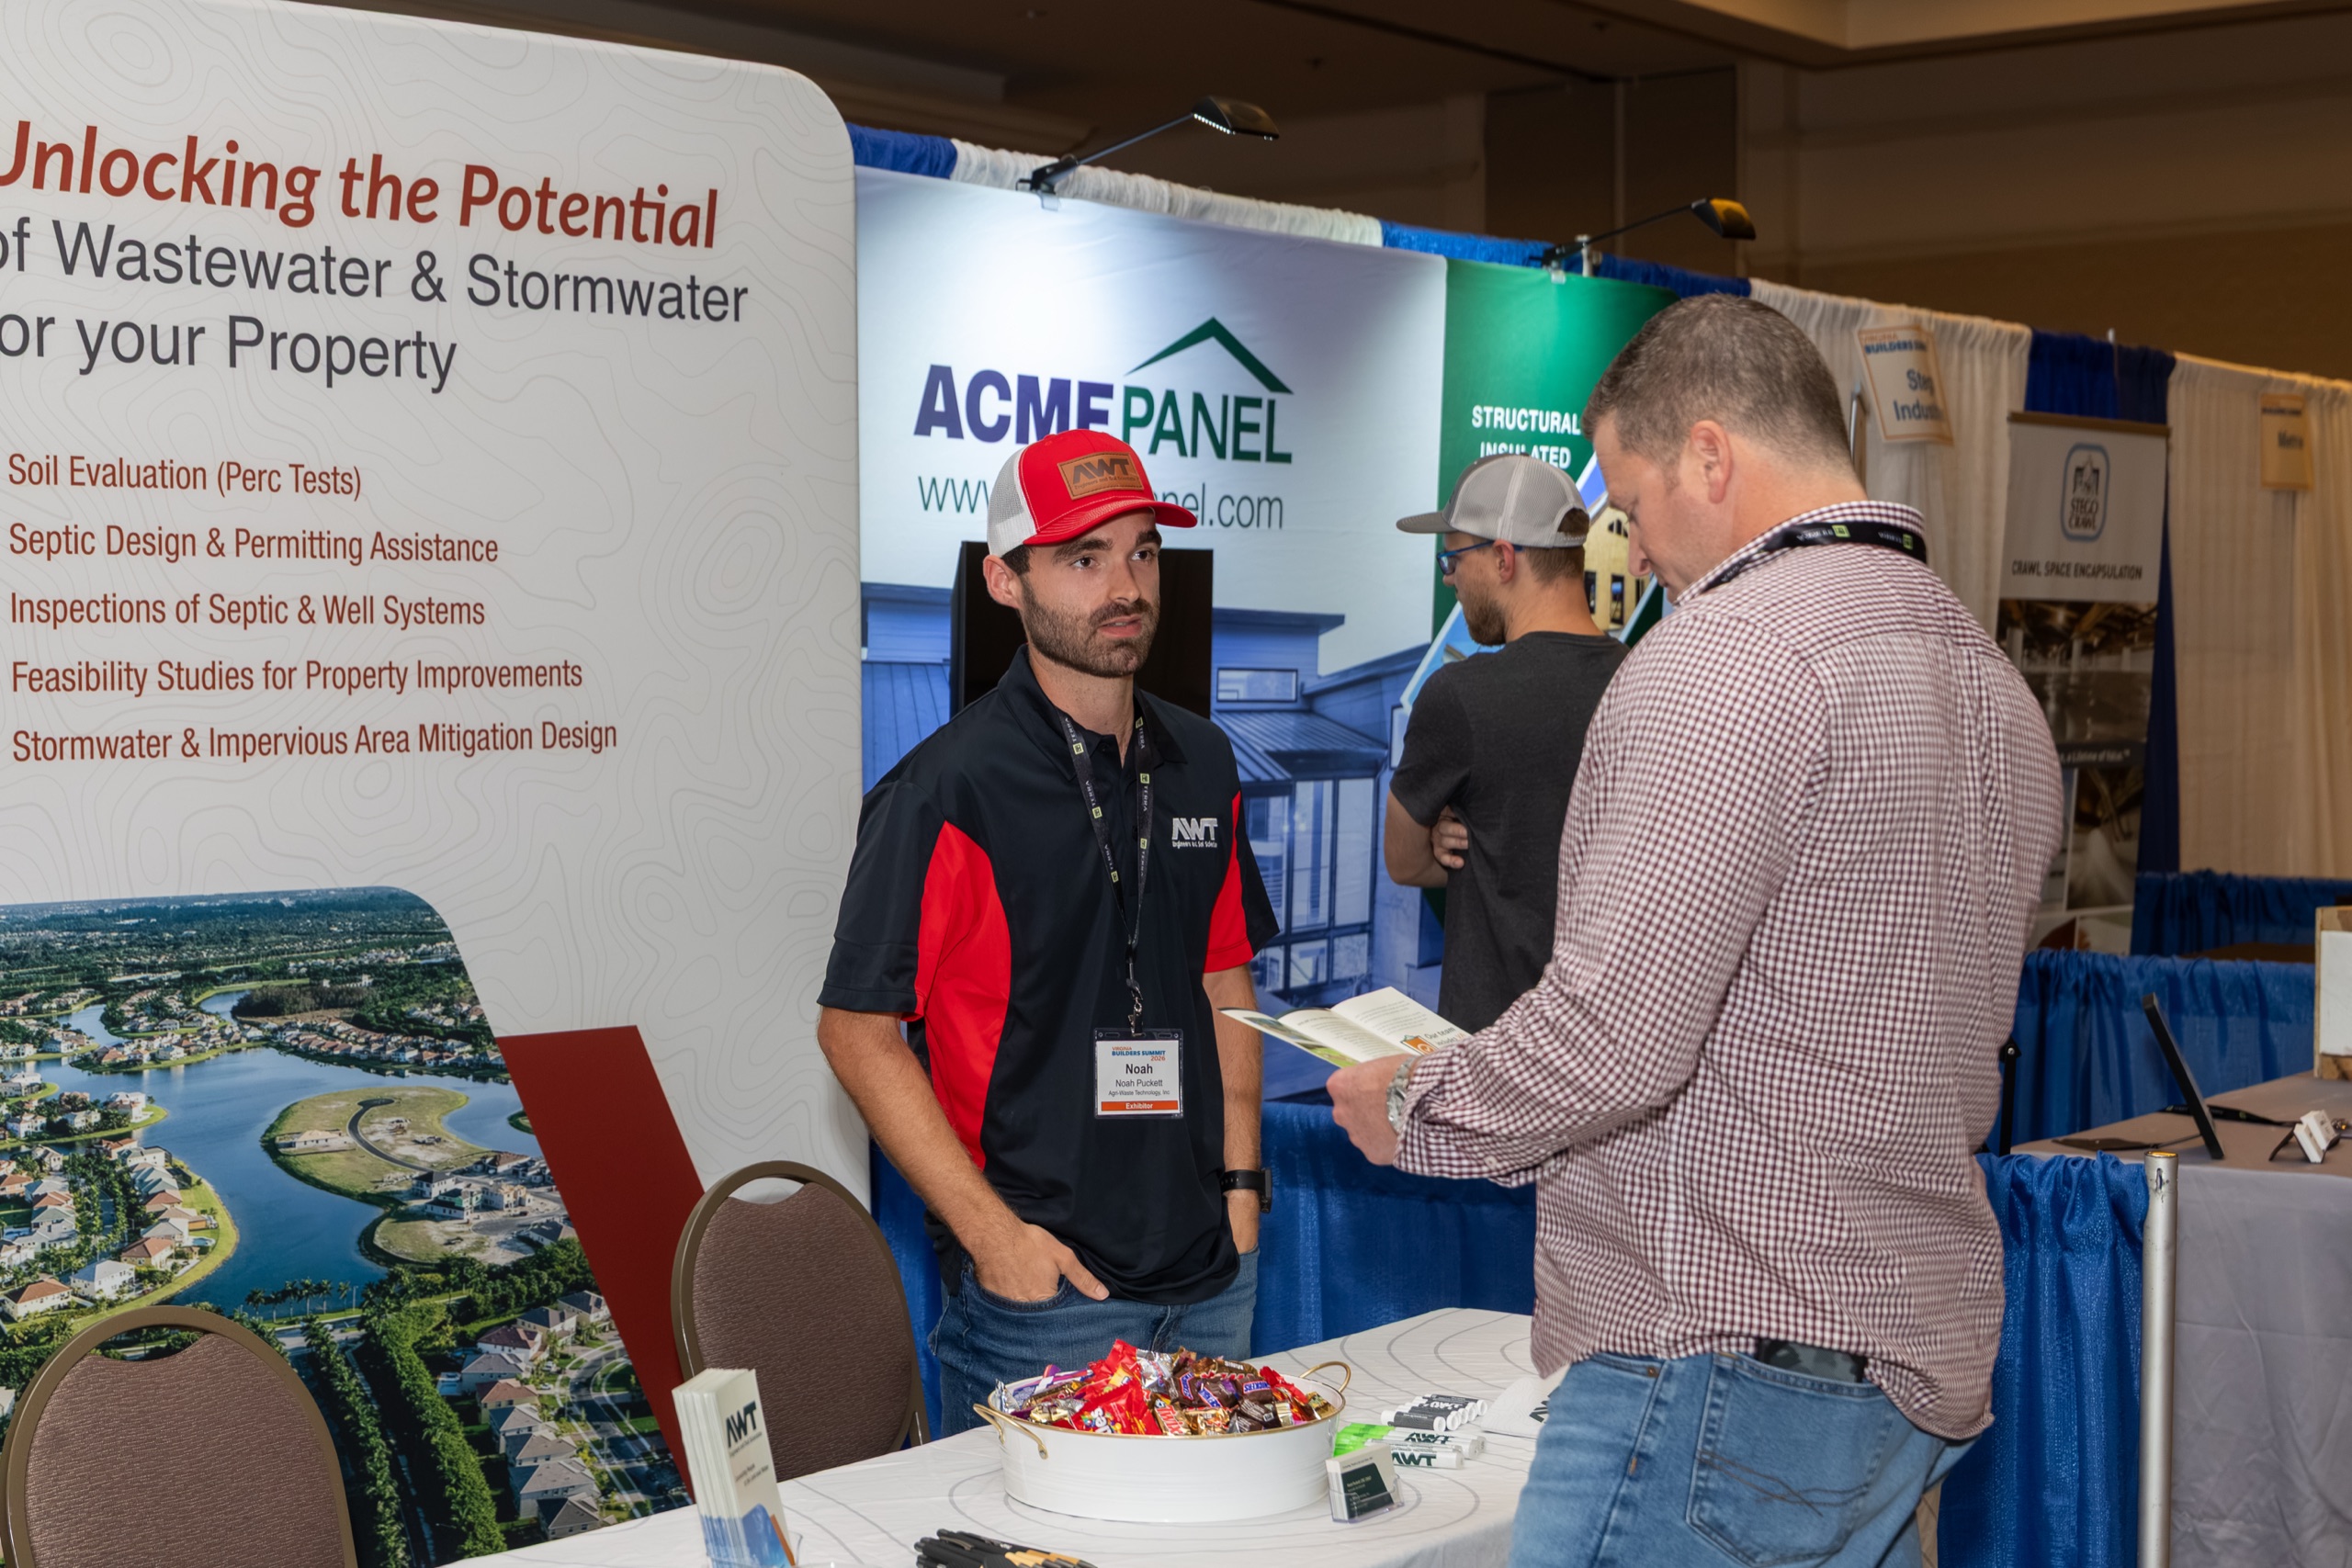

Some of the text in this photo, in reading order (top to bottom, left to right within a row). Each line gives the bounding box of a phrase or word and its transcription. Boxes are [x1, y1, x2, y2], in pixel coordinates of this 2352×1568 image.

[0, 120, 719, 250] Unlocking the Potential
[0, 217, 749, 322] f Wastewater & Stormwater
[75, 317, 206, 377] your
[229, 315, 458, 395] Property
[1123, 385, 1293, 464] PANEL
[1472, 405, 1582, 435] STRUCTURAL
[9, 454, 363, 502] Soil Evaluation (Perc Tests)
[1073, 457, 1130, 485] AWT
[2071, 497, 2099, 514] STEGO
[2068, 513, 2097, 530] CRAWL
[9, 523, 499, 567] Septic Design & Permitting Assistance
[2012, 559, 2143, 581] CRAWL SPACE ENCAPSULATION
[11, 592, 485, 631] Inspections of Septic & Well Systems
[12, 659, 582, 698] Feasibility Studies for Property Improvements
[13, 719, 617, 763] Stormwater & Impervious Area Mitigation Design
[1085, 780, 1096, 807] TERRA
[1171, 818, 1218, 840] AWT
[1424, 1026, 1456, 1040] Our team
[1115, 1078, 1163, 1087] Noah Puckett
[1125, 1063, 1153, 1074] Noah
[1108, 1089, 1134, 1098] Agri-Waste
[725, 1400, 757, 1449] AWT
[1155, 1404, 1184, 1435] Twix
[1392, 1452, 1437, 1467] AWT
